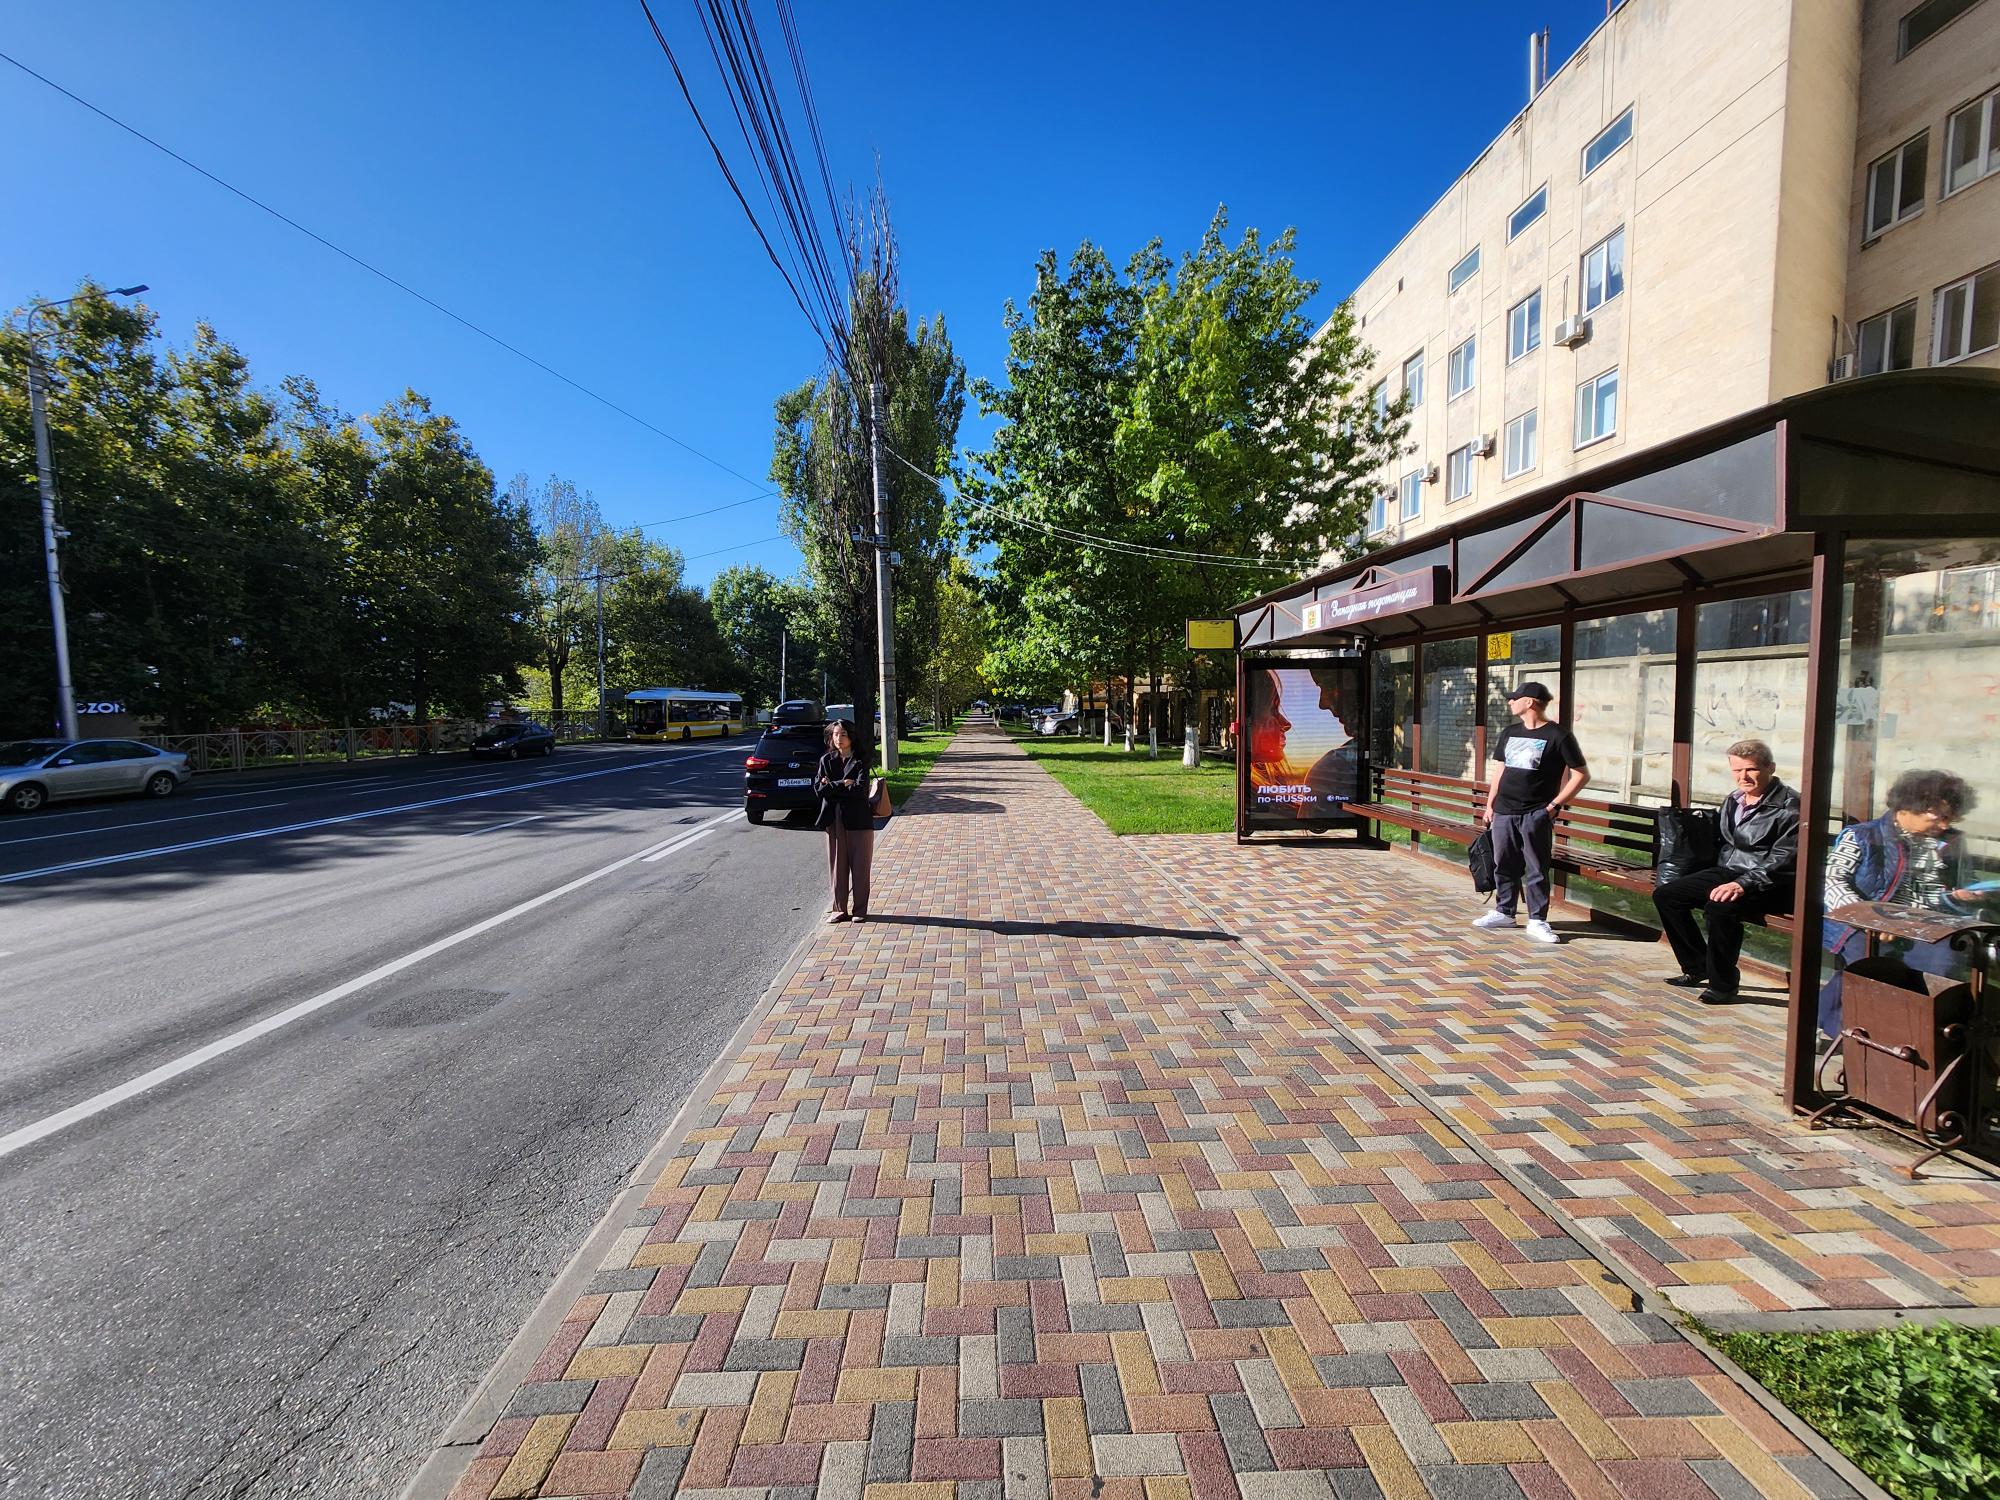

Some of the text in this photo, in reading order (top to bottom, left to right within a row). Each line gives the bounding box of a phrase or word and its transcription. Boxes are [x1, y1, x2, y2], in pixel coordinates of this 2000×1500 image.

[1331, 587, 1418, 620] Западная подстанция
[1257, 785, 1312, 794] ЛЮБИТЬ
[1257, 795, 1318, 803] по-RUSSки
